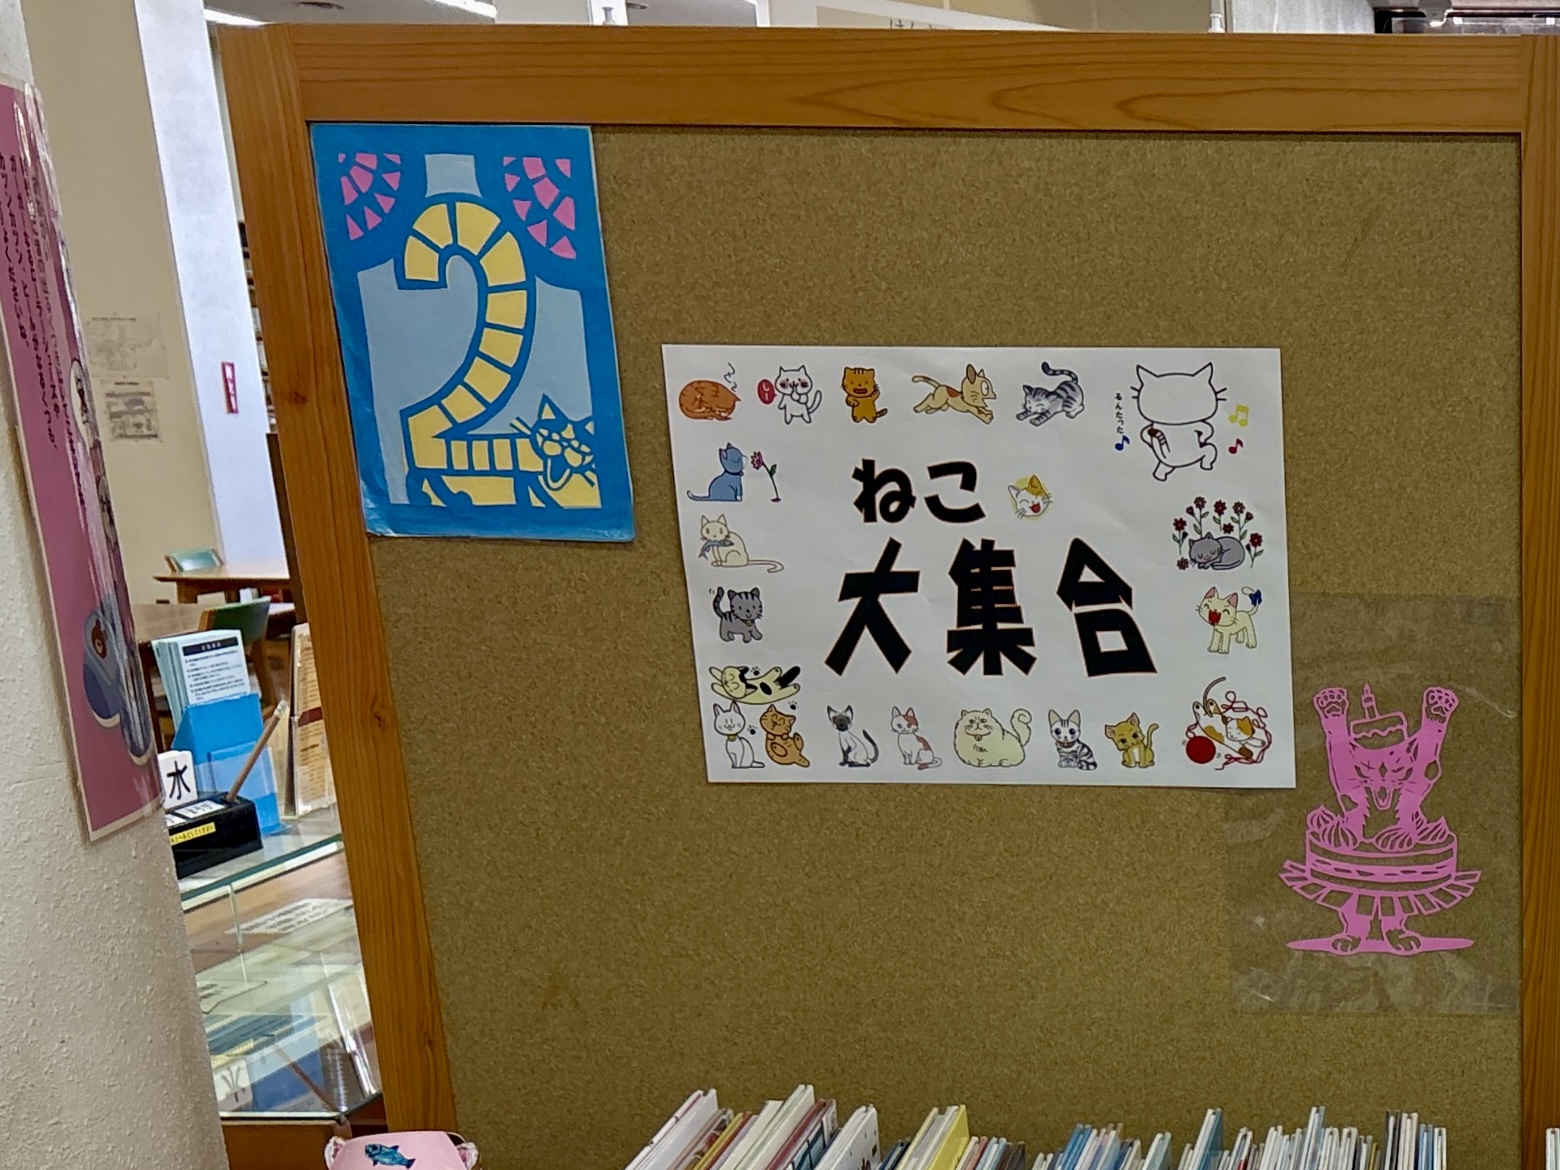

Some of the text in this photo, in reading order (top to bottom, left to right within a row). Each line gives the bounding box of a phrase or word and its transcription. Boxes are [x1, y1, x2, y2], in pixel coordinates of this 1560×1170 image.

[1115, 392, 1124, 434] るんたった
[852, 457, 985, 523] ねこ
[824, 536, 1159, 678] 大集合
[166, 760, 193, 801] 水
